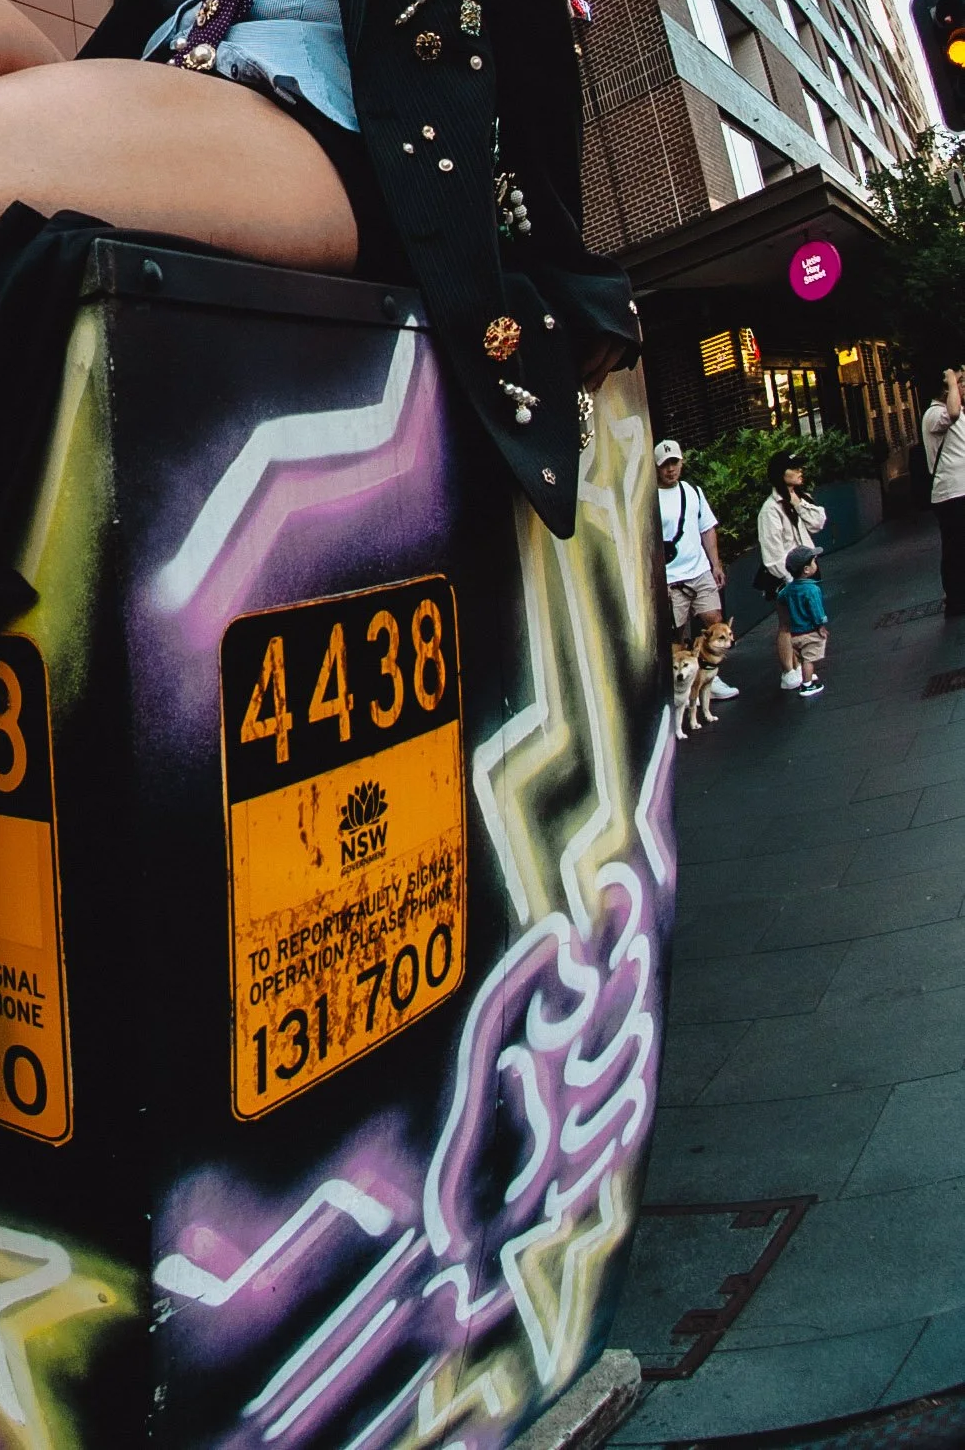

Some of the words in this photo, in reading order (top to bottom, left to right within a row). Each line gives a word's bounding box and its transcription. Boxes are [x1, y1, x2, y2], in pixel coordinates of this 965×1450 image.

[240, 599, 446, 764] 4438
[341, 821, 387, 866] NSW
[249, 947, 270, 976] TO
[278, 911, 343, 963] REPORT
[348, 879, 402, 925] FAULTY
[408, 853, 454, 892] SIGNAL
[250, 940, 344, 1005] OPERATION
[350, 906, 405, 955] PLEASE
[411, 878, 453, 919] PHONE
[252, 993, 328, 1095] 131
[357, 923, 452, 1032] 700
